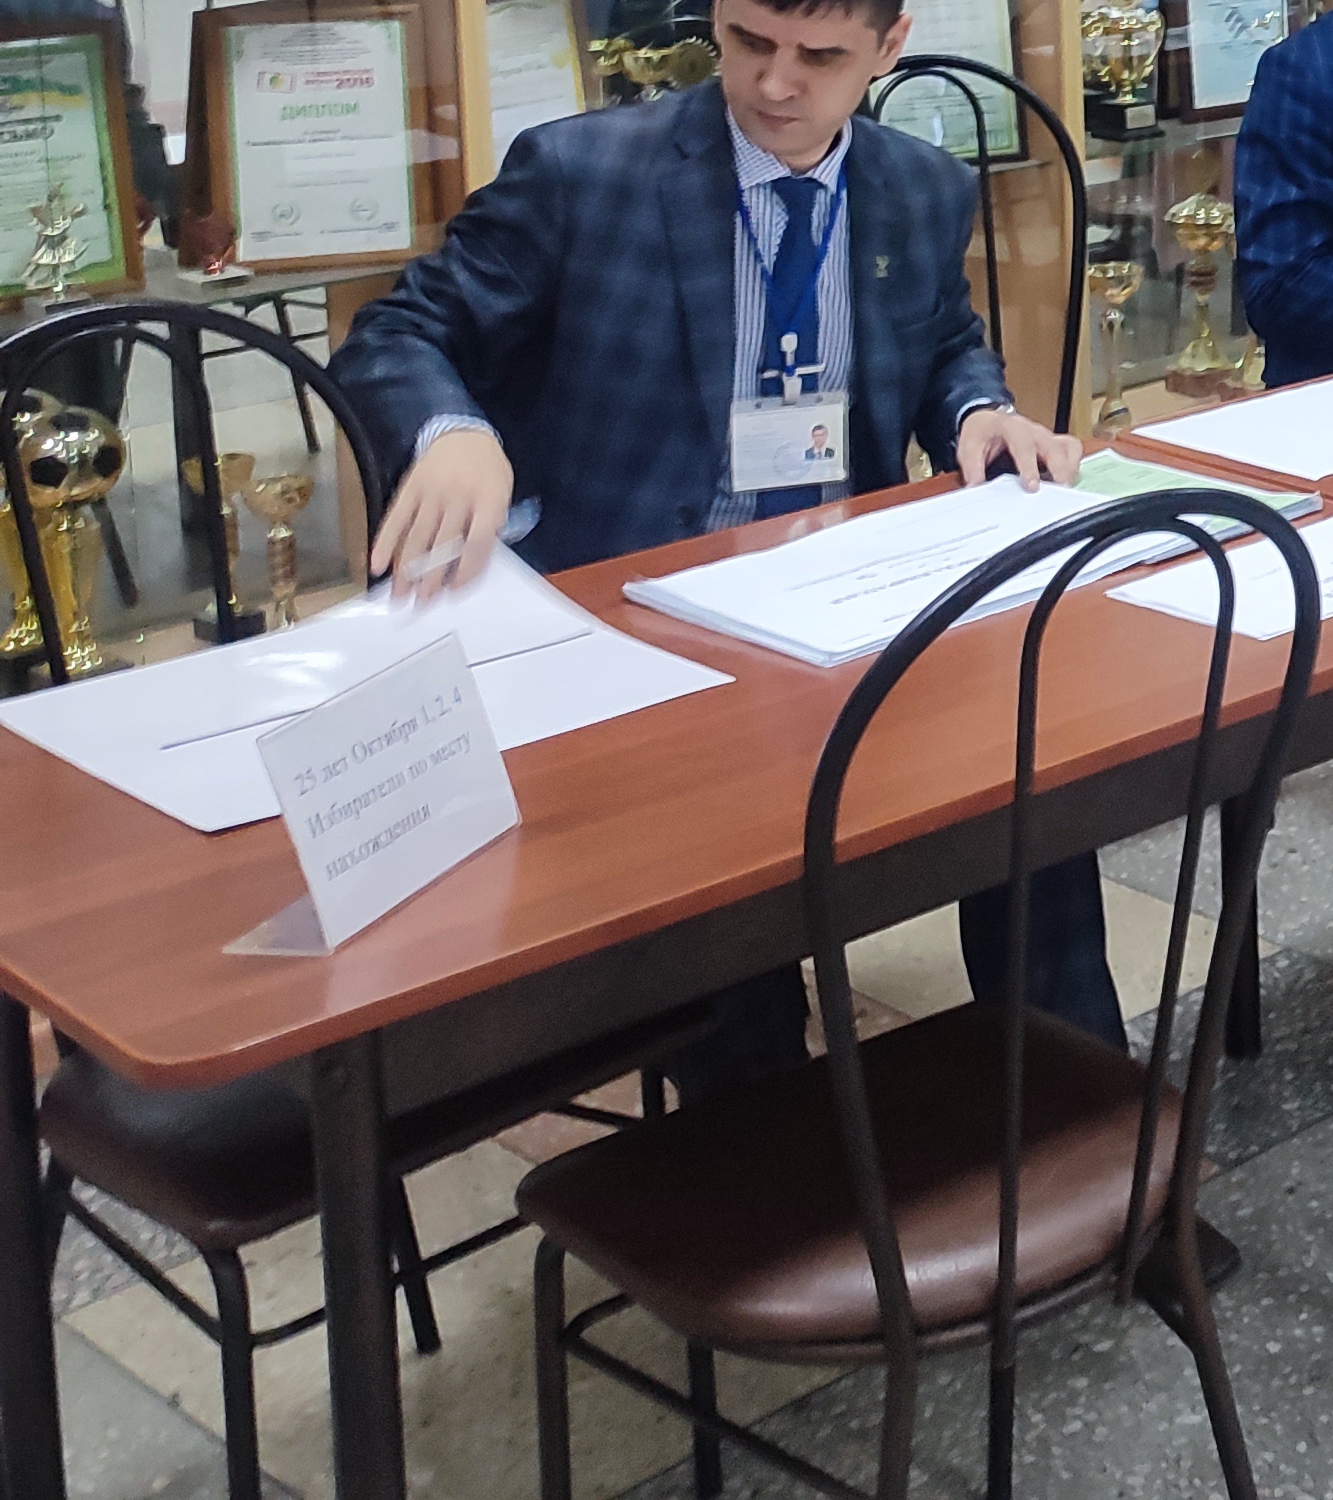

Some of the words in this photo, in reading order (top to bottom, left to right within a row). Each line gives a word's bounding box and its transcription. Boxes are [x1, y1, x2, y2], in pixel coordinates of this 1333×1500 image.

[294, 768, 317, 798] 25
[321, 756, 349, 784] лет
[351, 716, 420, 764] Октября
[304, 769, 407, 840] Избиратели
[408, 759, 429, 781] по
[431, 731, 472, 768] месту
[323, 802, 432, 883] нахождения
